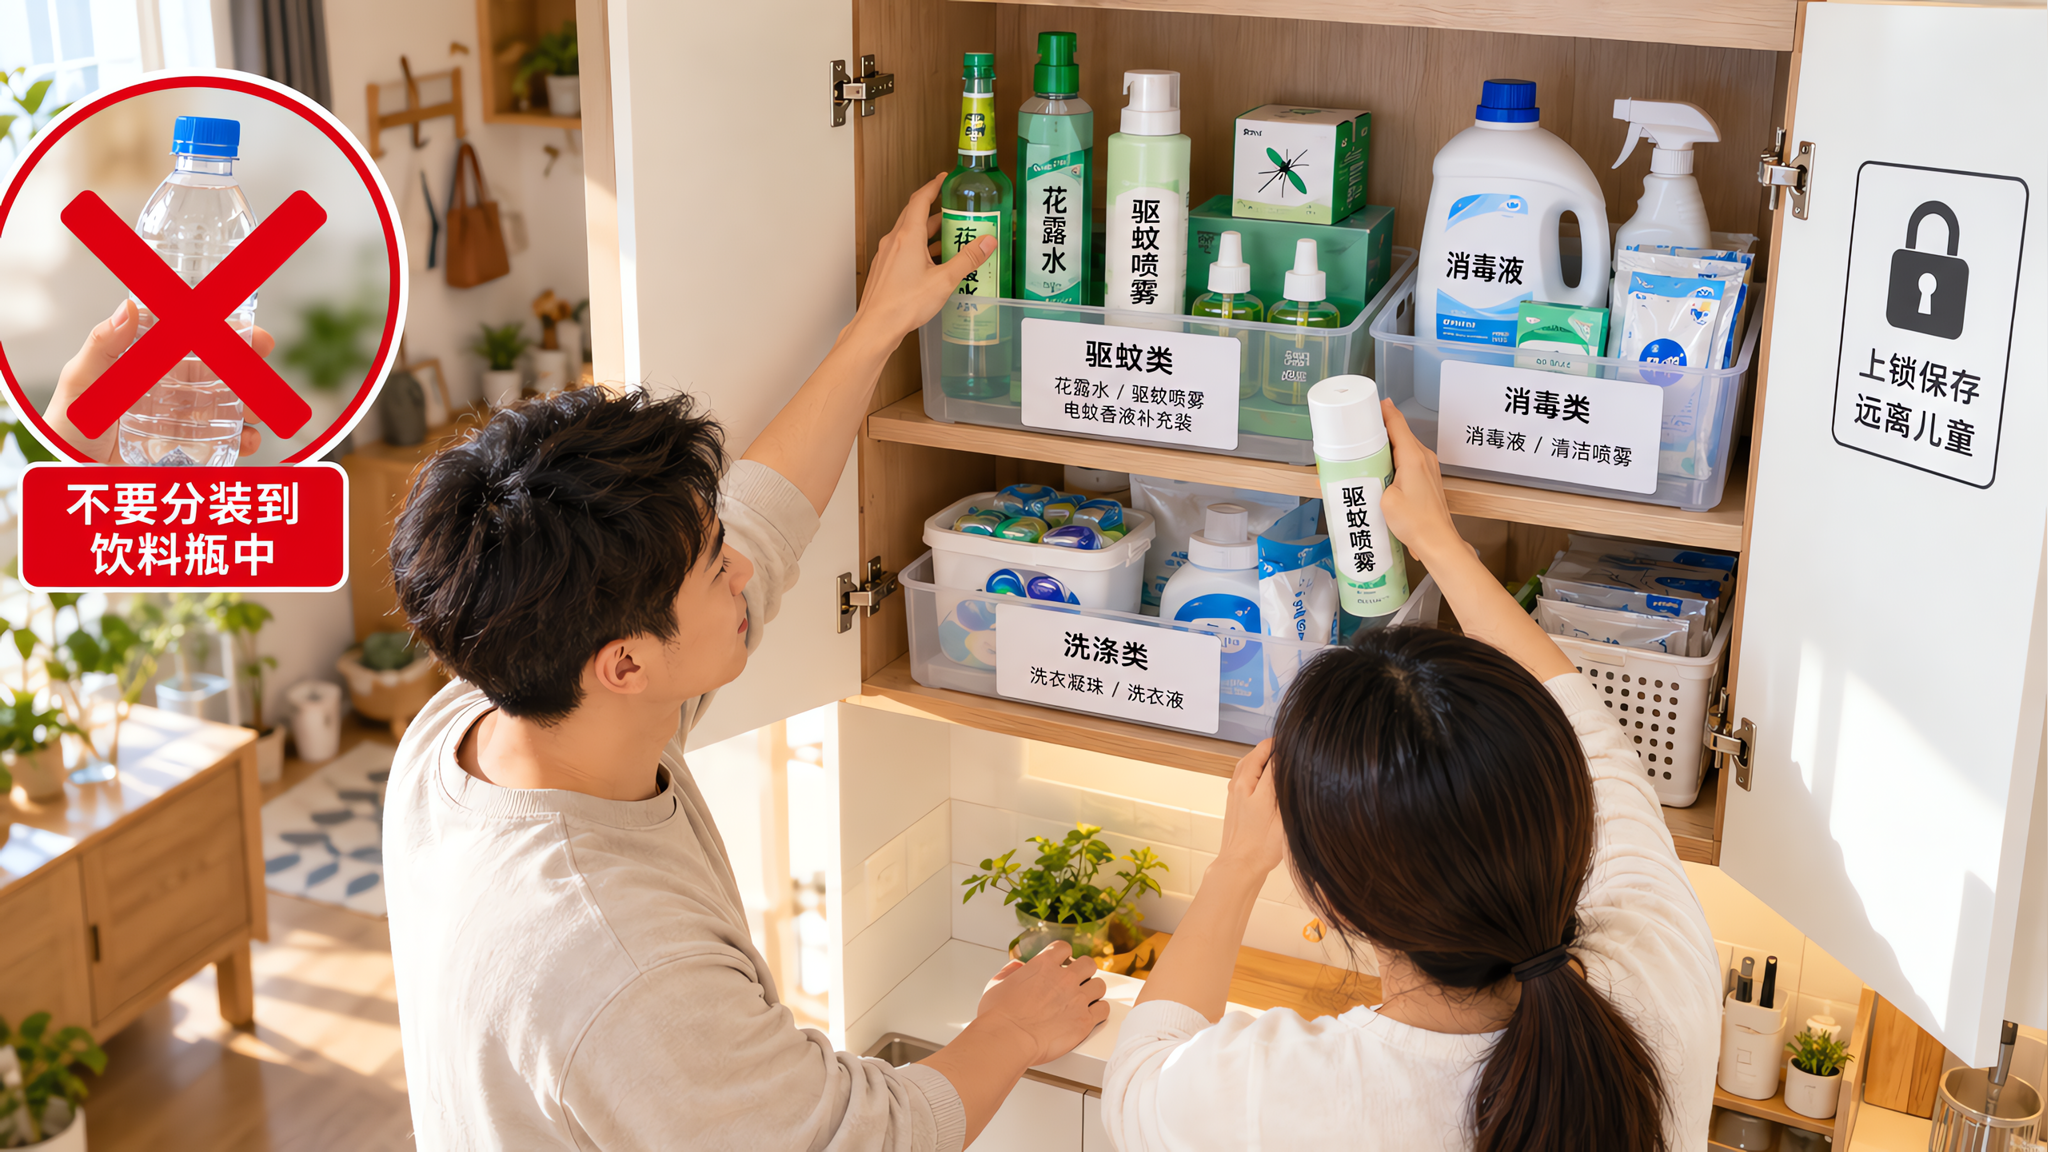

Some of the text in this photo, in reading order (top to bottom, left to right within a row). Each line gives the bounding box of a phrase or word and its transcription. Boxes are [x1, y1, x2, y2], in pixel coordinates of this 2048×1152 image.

[1042, 186, 1067, 274] 花露水
[1130, 199, 1160, 305] 驱蚊喷雾
[1446, 250, 1524, 286] 消毒液
[1085, 340, 1173, 375] 驱蚊类
[1859, 348, 1981, 405] 上锁保存
[1064, 400, 1192, 432] 电蚊香液补充装
[1504, 386, 1590, 424] 消毒类
[1854, 393, 1975, 457] 远离儿童
[1465, 425, 1527, 453] 消毒液
[1551, 437, 1633, 467] 清洁喷雾
[1341, 486, 1376, 573] 驱蚊喷雾
[1064, 631, 1148, 671] 洗涤类
[1030, 666, 1104, 695] 洗衣凝珠
[1127, 683, 1184, 710] 洗衣液
